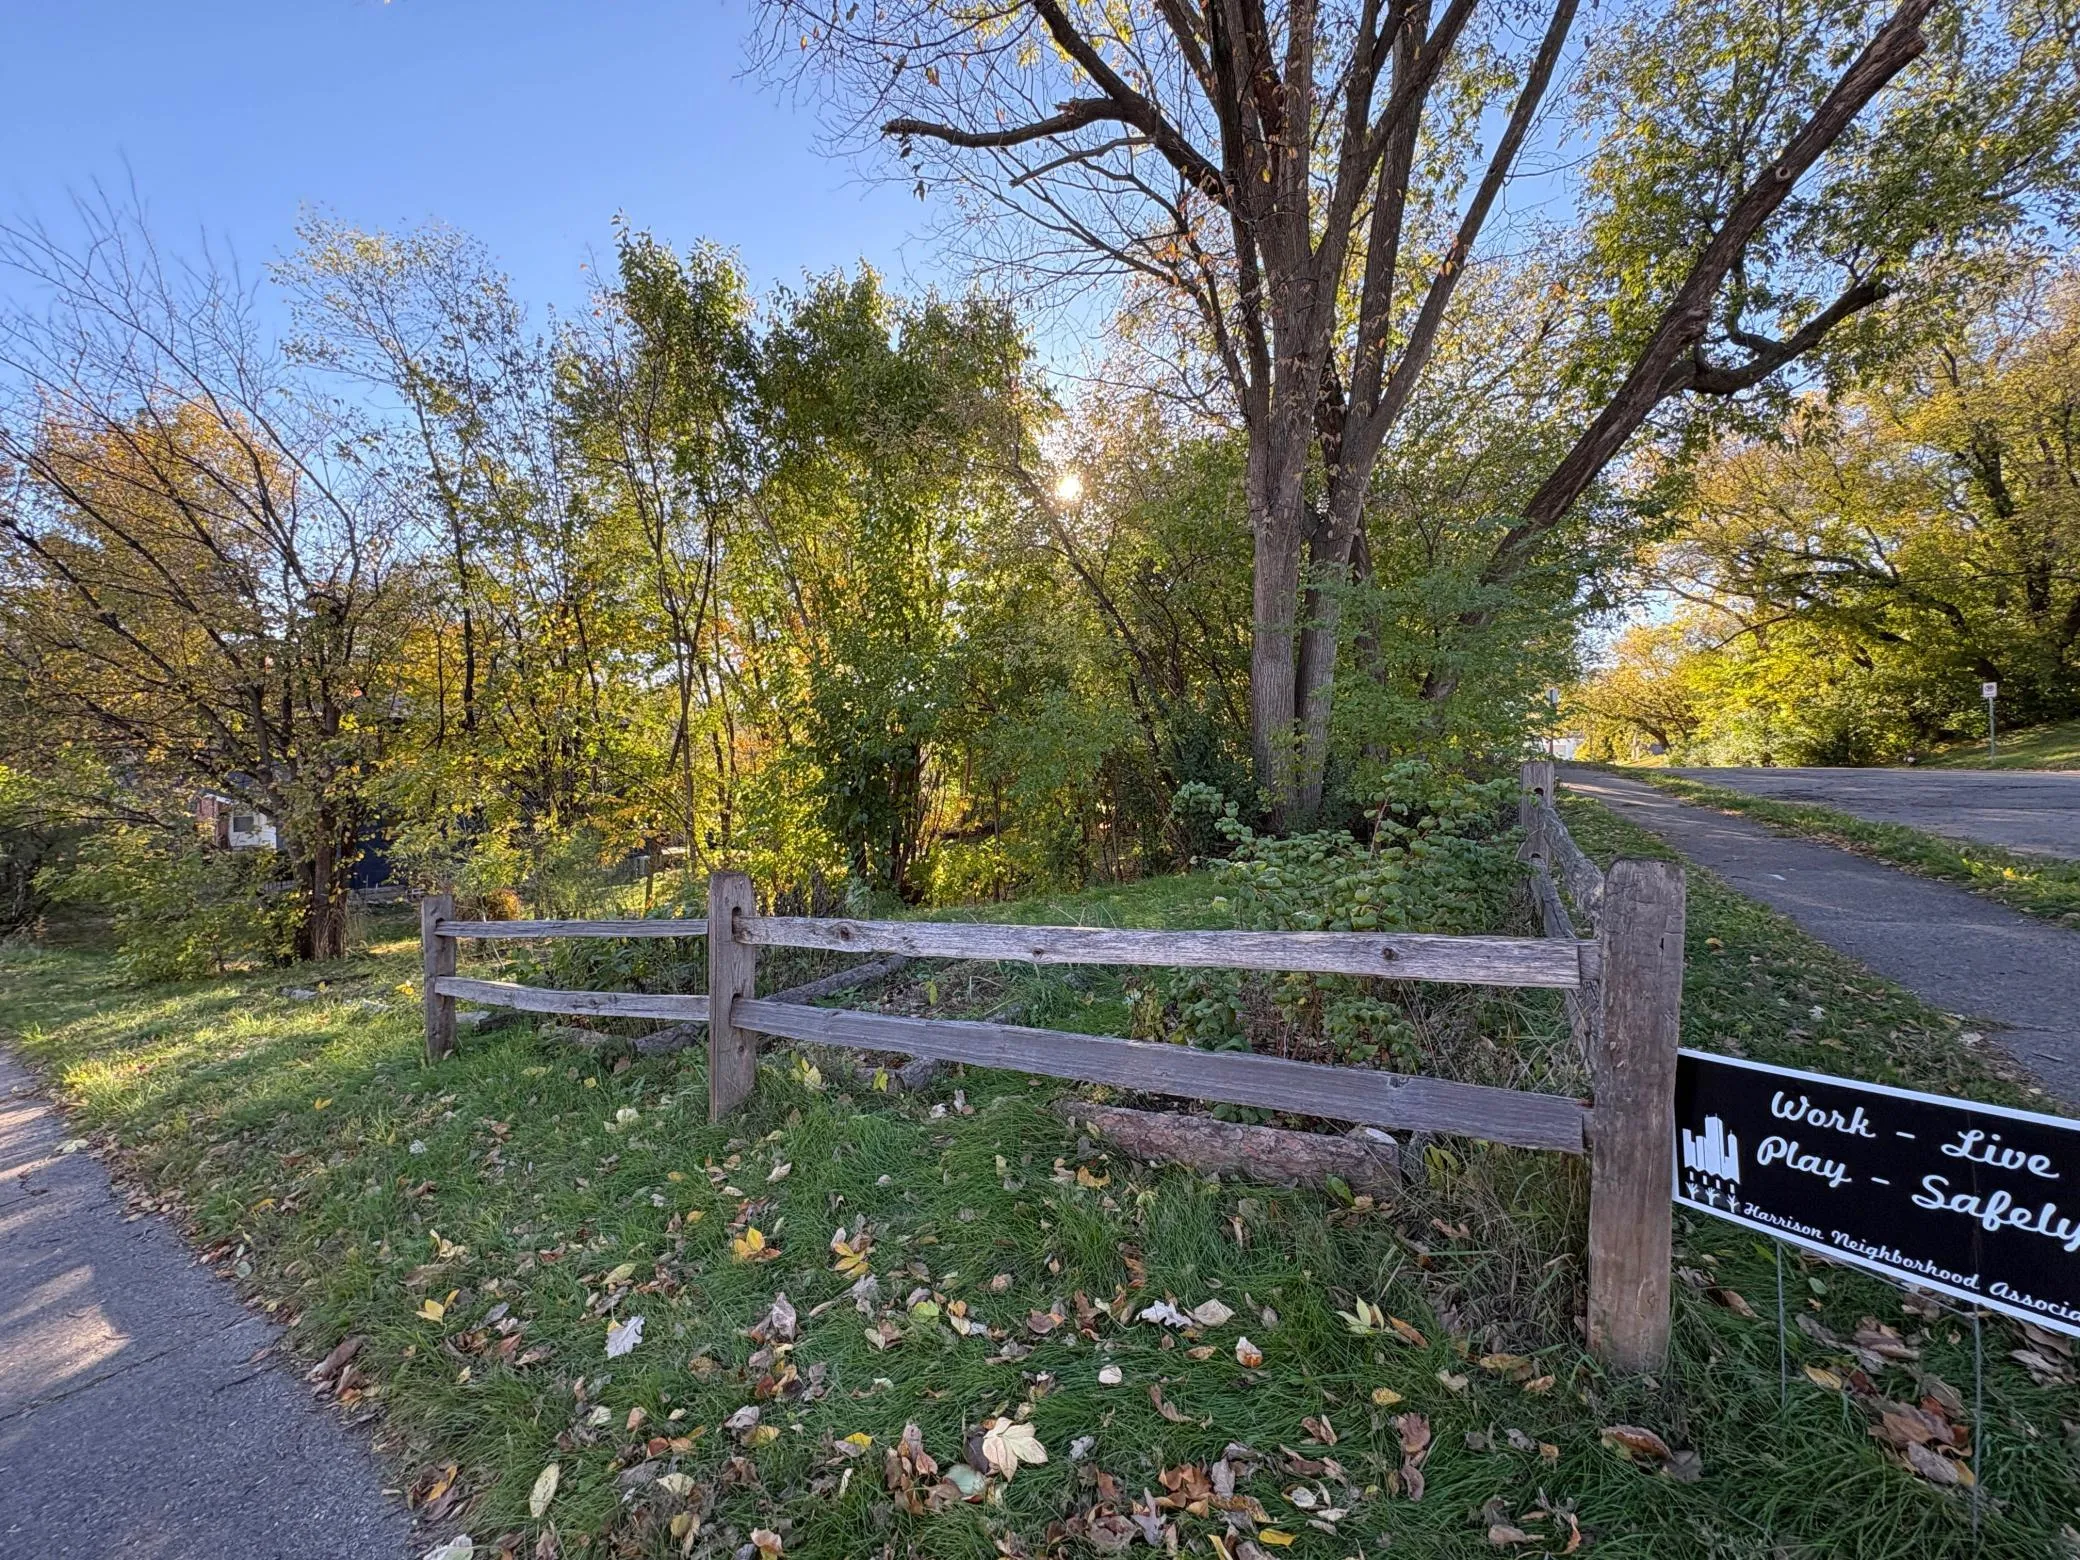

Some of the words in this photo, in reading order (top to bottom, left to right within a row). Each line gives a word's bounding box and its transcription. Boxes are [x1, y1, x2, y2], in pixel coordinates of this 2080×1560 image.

[1771, 1090, 1876, 1138] Work
[1896, 1131, 1916, 1139] -
[1941, 1129, 2060, 1179] Live
[1757, 1136, 1852, 1188] Play
[1871, 1177, 1890, 1185] -
[1911, 1175, 2080, 1252] Safely
[1744, 1203, 1824, 1240] Harrison
[1831, 1231, 1980, 1289] Neighborhood
